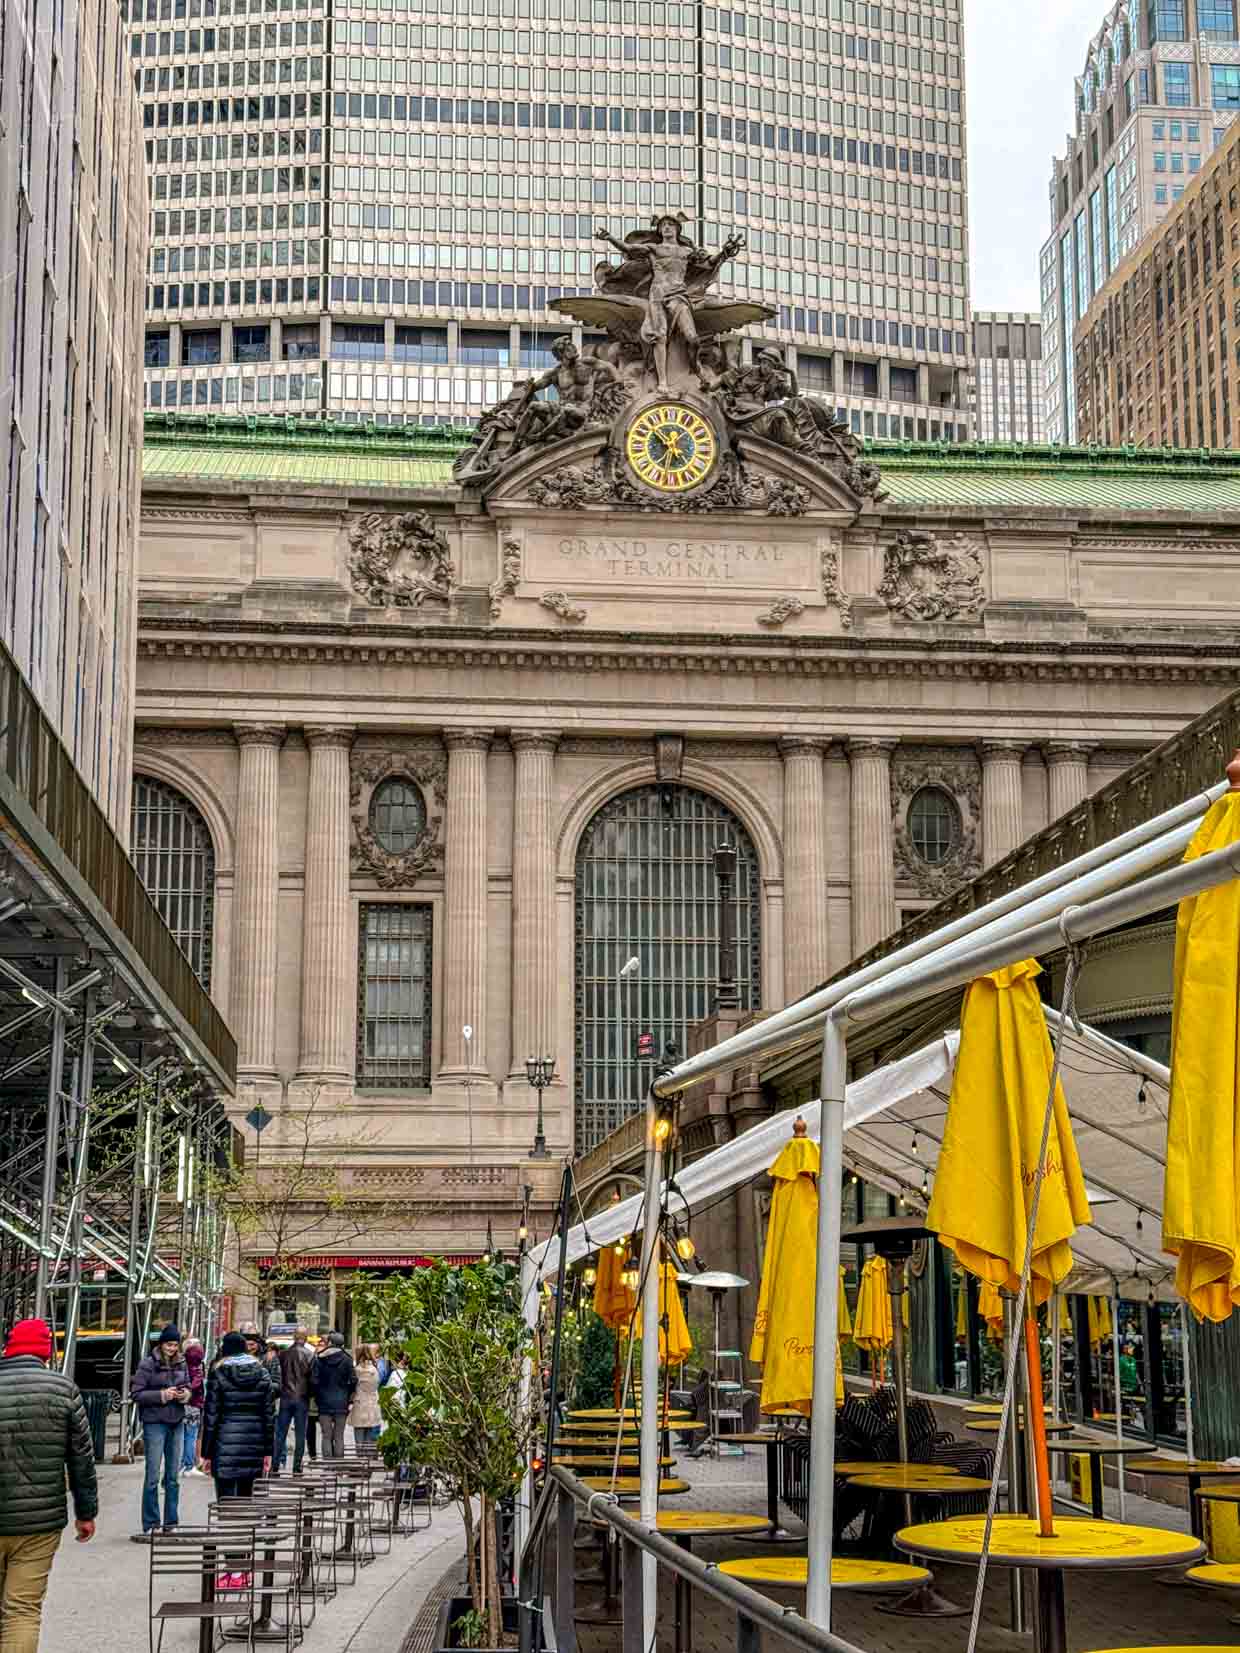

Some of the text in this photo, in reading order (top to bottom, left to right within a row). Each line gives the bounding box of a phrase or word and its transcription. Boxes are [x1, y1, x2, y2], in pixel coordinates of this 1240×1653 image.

[559, 539, 785, 561] GRAND CENTRAL
[607, 559, 734, 579] TERMINAL
